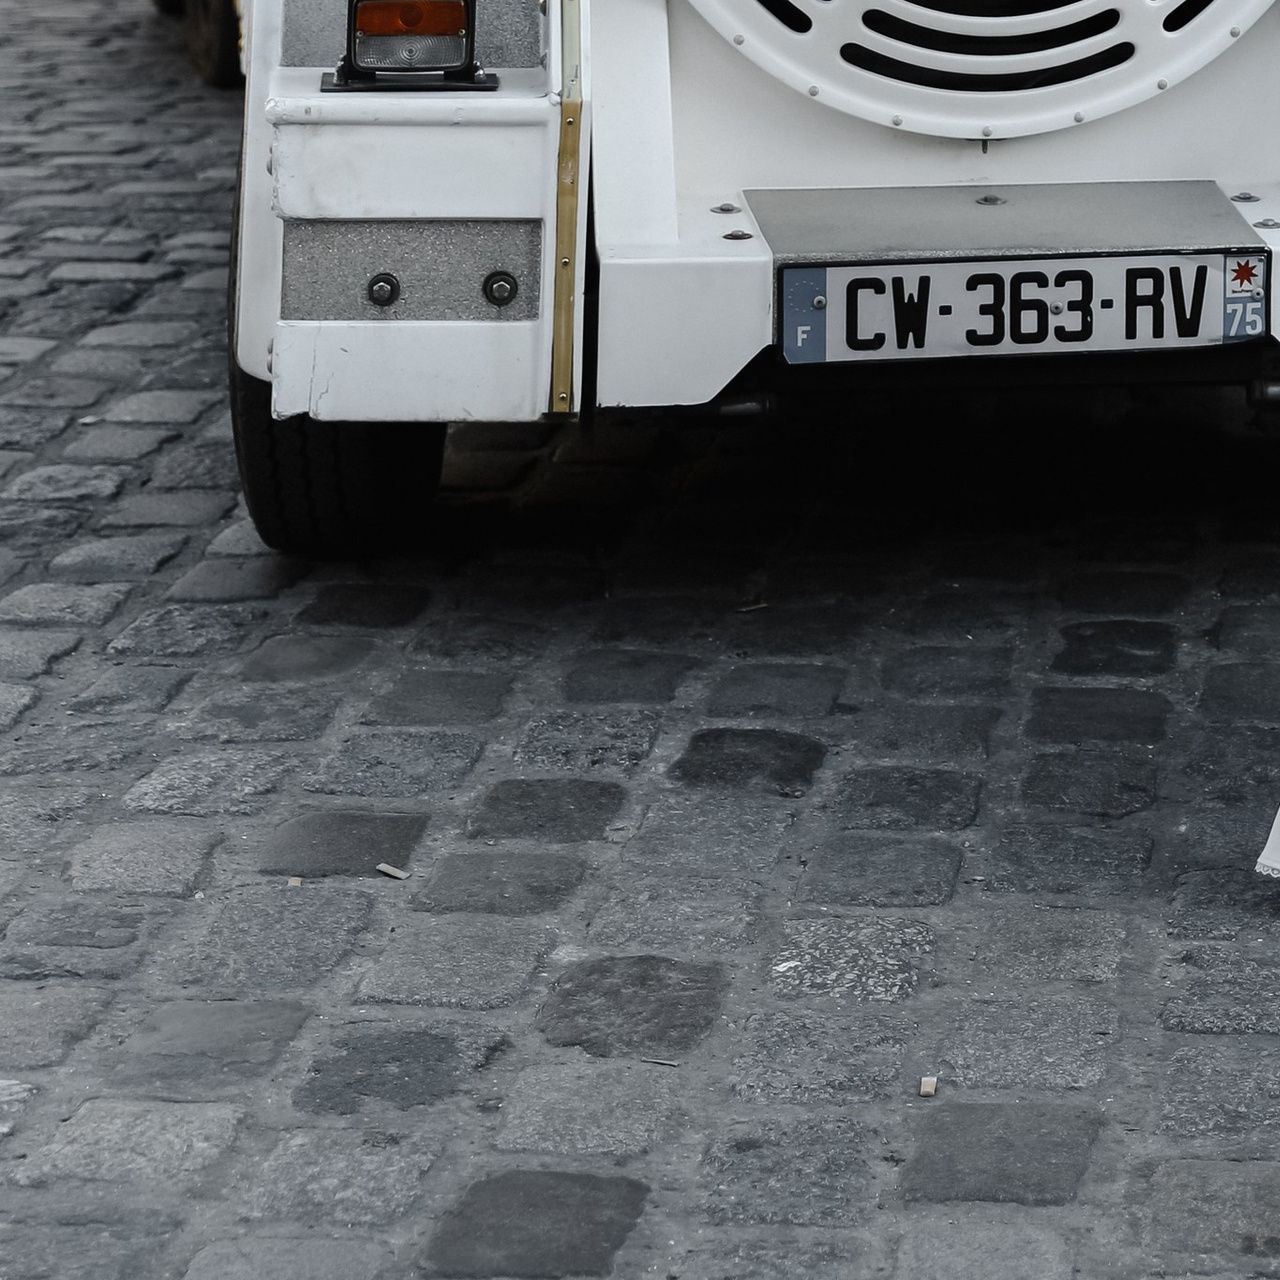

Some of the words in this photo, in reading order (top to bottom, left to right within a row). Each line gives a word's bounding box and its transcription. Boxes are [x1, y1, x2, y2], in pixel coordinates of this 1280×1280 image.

[845, 264, 1209, 352] CW-363-RV
[1226, 302, 1263, 337] 75
[797, 324, 812, 348] F
